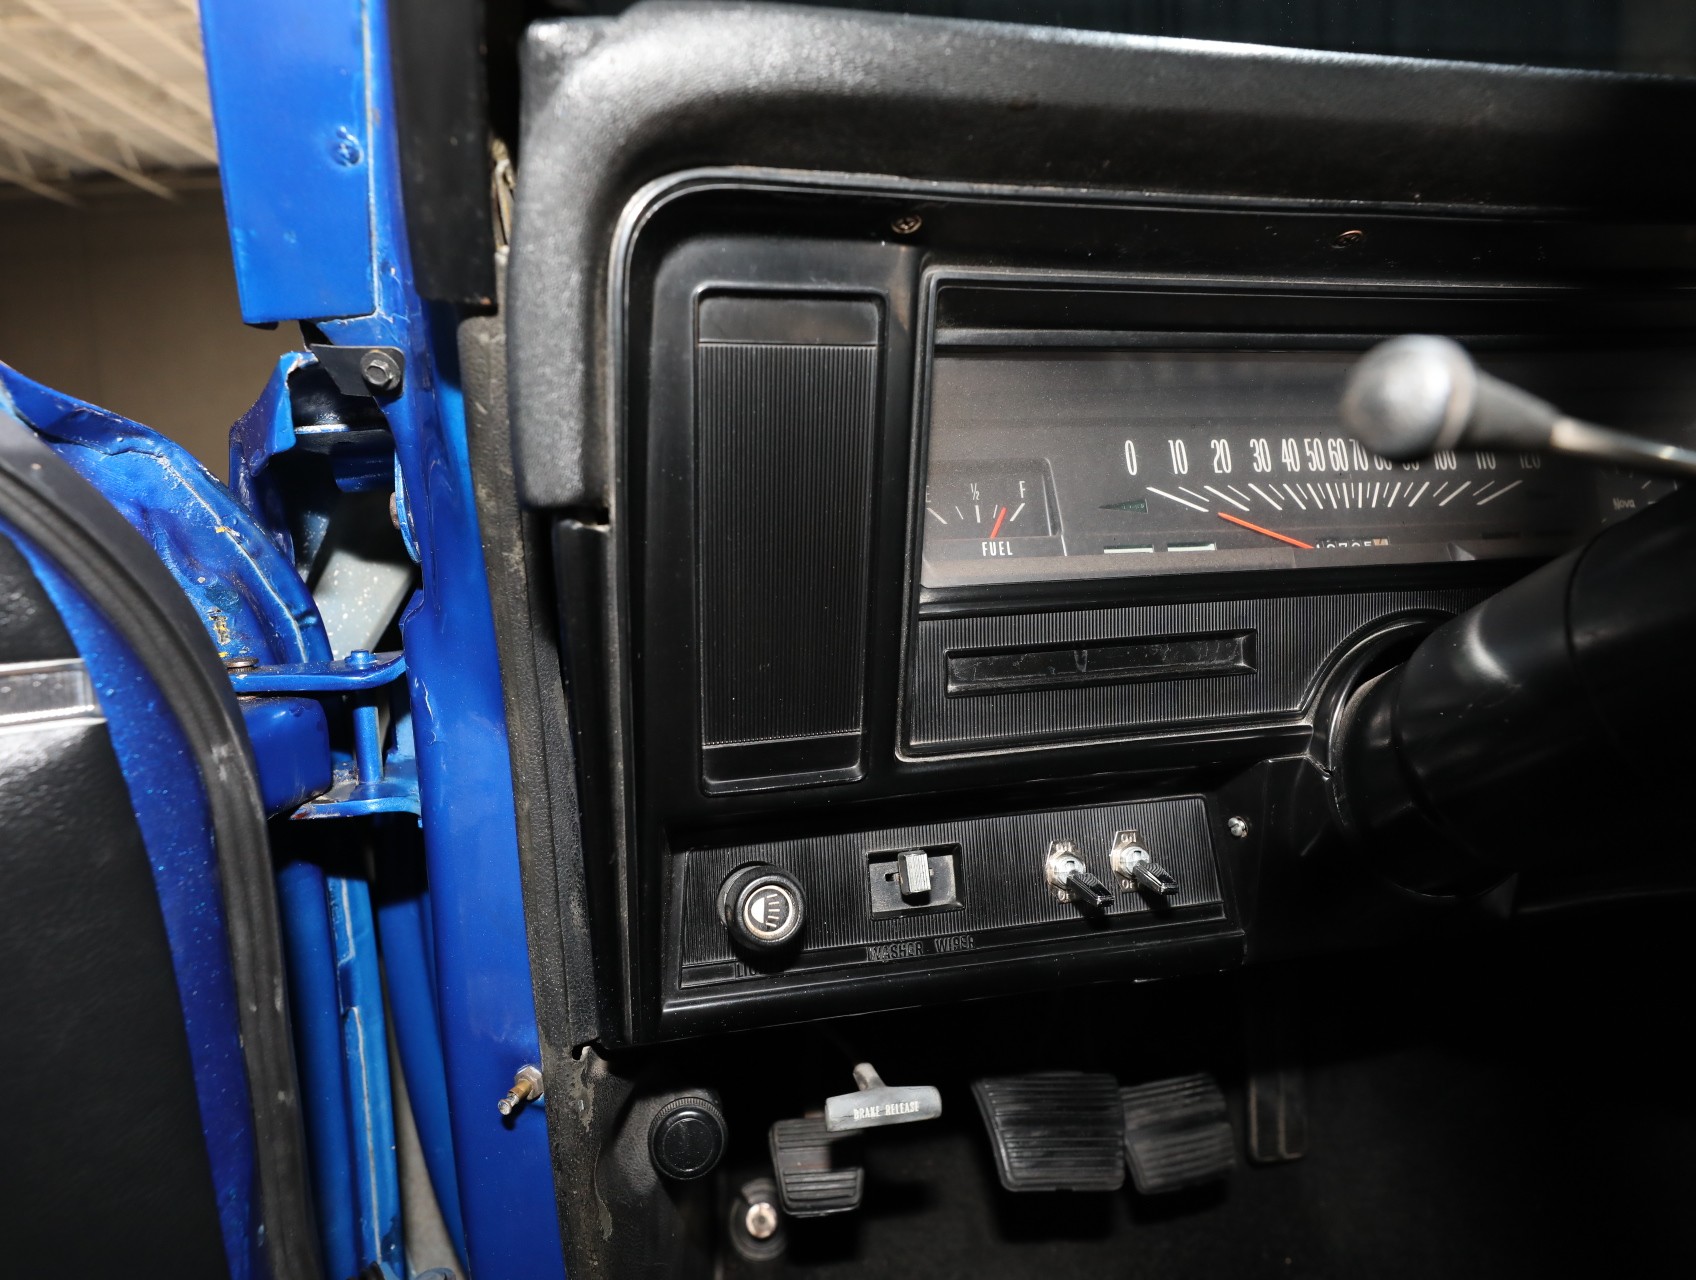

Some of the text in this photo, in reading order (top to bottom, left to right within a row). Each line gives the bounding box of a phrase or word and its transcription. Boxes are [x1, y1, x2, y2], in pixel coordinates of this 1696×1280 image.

[1124, 439, 1138, 476] 0
[1168, 439, 1188, 475] 10
[1210, 438, 1232, 474] 20
[1249, 438, 1272, 473] 30
[1281, 438, 1301, 473] 40
[1303, 438, 1326, 472] 50
[1327, 438, 1349, 472] 60
[1348, 438, 1369, 471] 70
[1019, 480, 1026, 499] F
[981, 541, 1014, 557] FUEL
[867, 936, 975, 963] WASHER WIPER
[853, 1101, 919, 1120] BRAKE RELEASE
